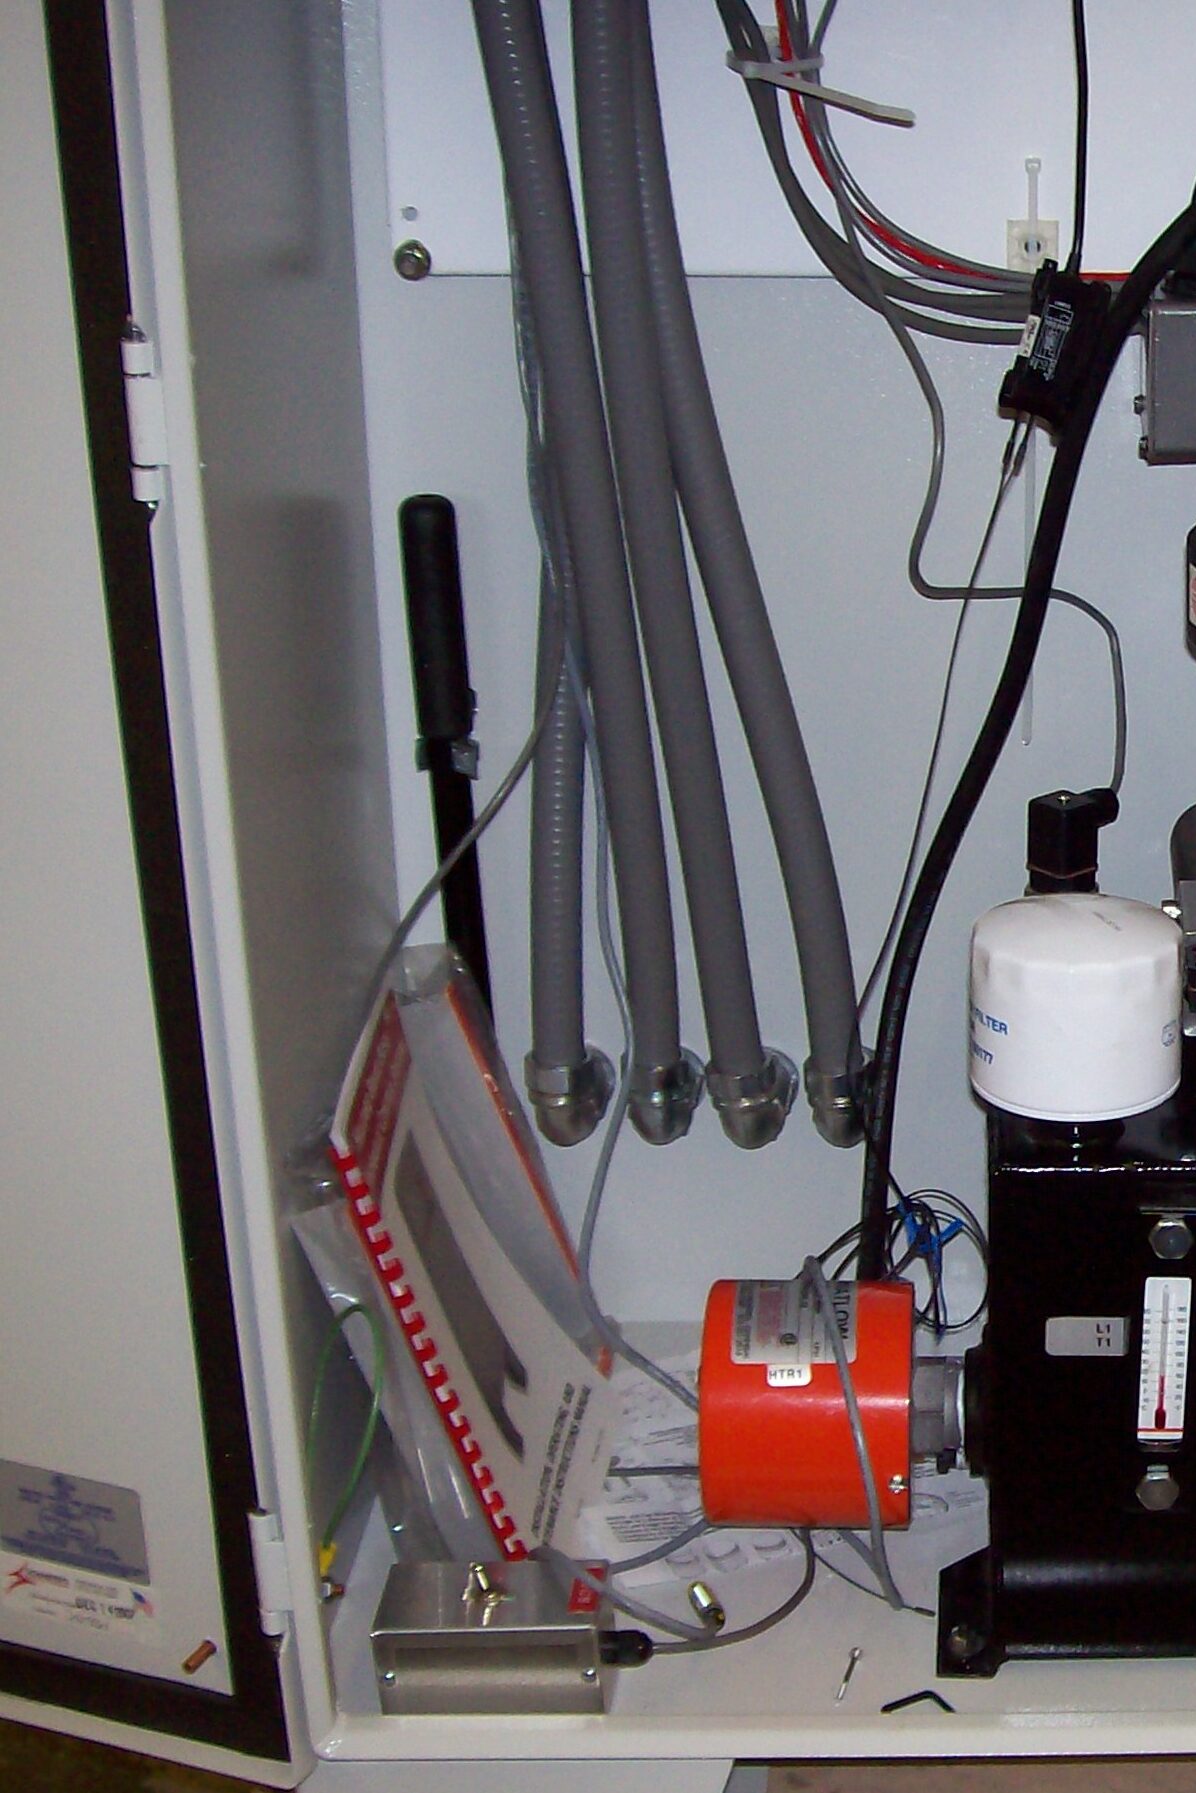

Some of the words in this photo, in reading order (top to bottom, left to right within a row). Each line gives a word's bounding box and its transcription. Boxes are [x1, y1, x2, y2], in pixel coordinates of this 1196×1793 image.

[1096, 1323, 1110, 1334] L1
[1096, 1337, 1111, 1347] T1
[768, 1368, 803, 1380] HTR1
